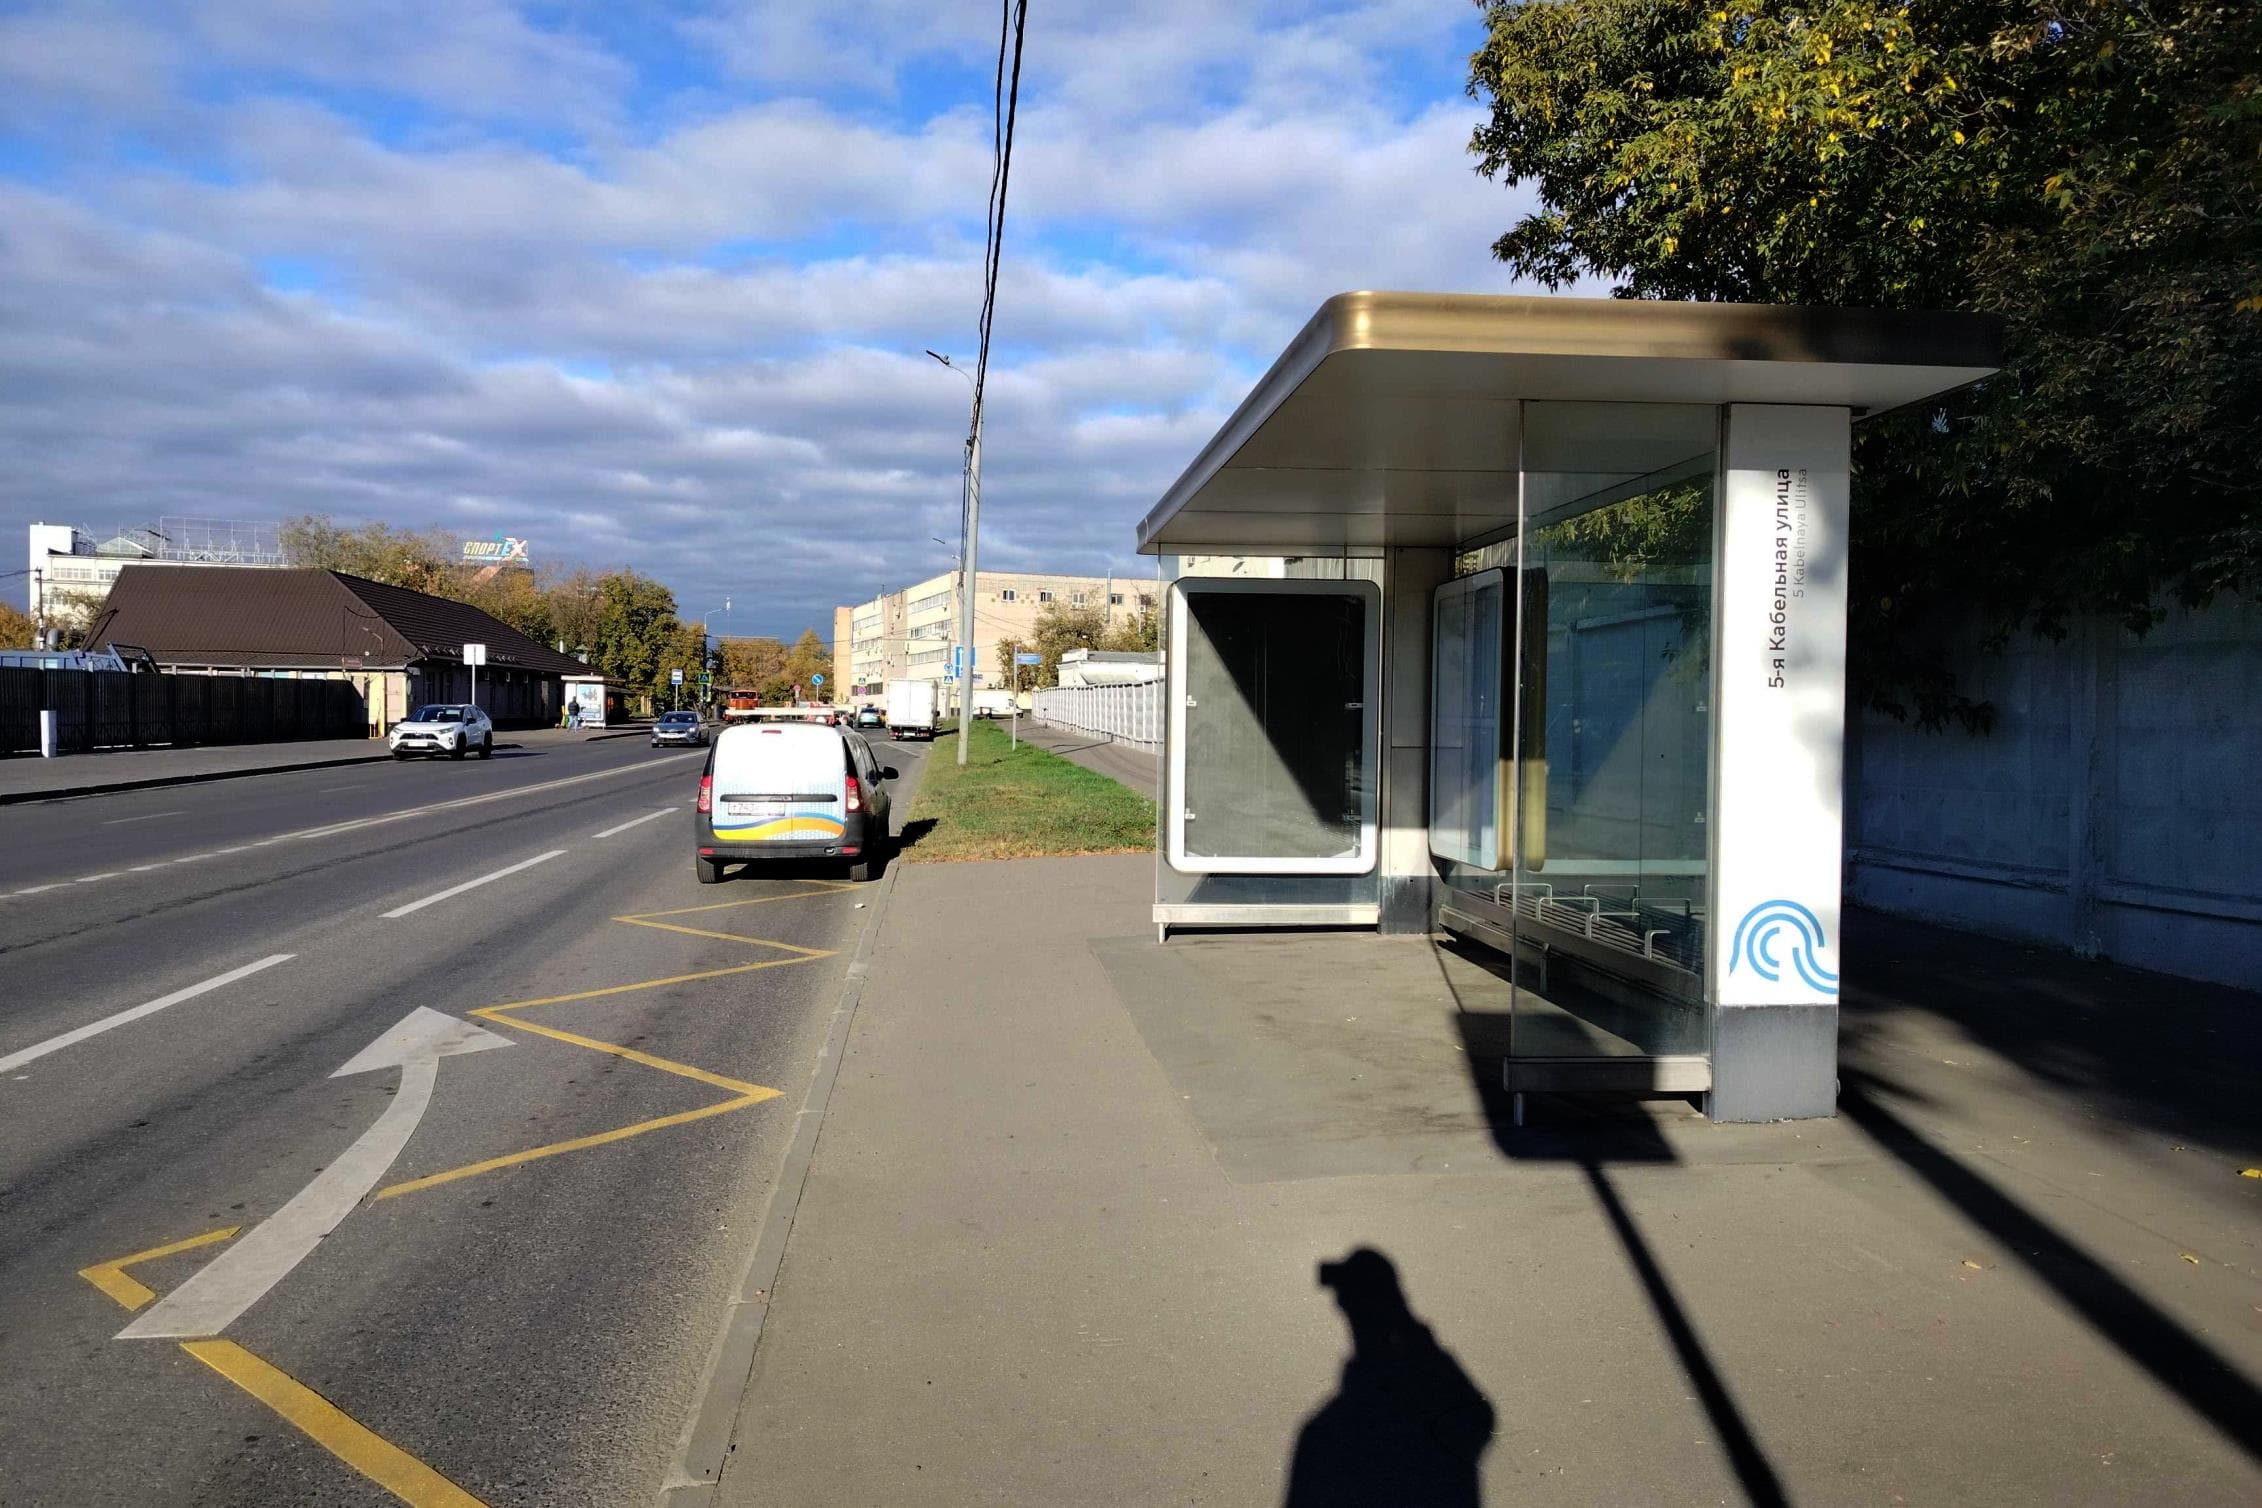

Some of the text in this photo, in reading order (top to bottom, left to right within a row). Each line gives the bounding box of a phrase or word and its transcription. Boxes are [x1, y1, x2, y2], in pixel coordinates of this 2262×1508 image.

[1768, 468, 1792, 688] 5-я Кабельная улица
[1793, 469, 1808, 598] 5 Kabelnaya Ulitsa
